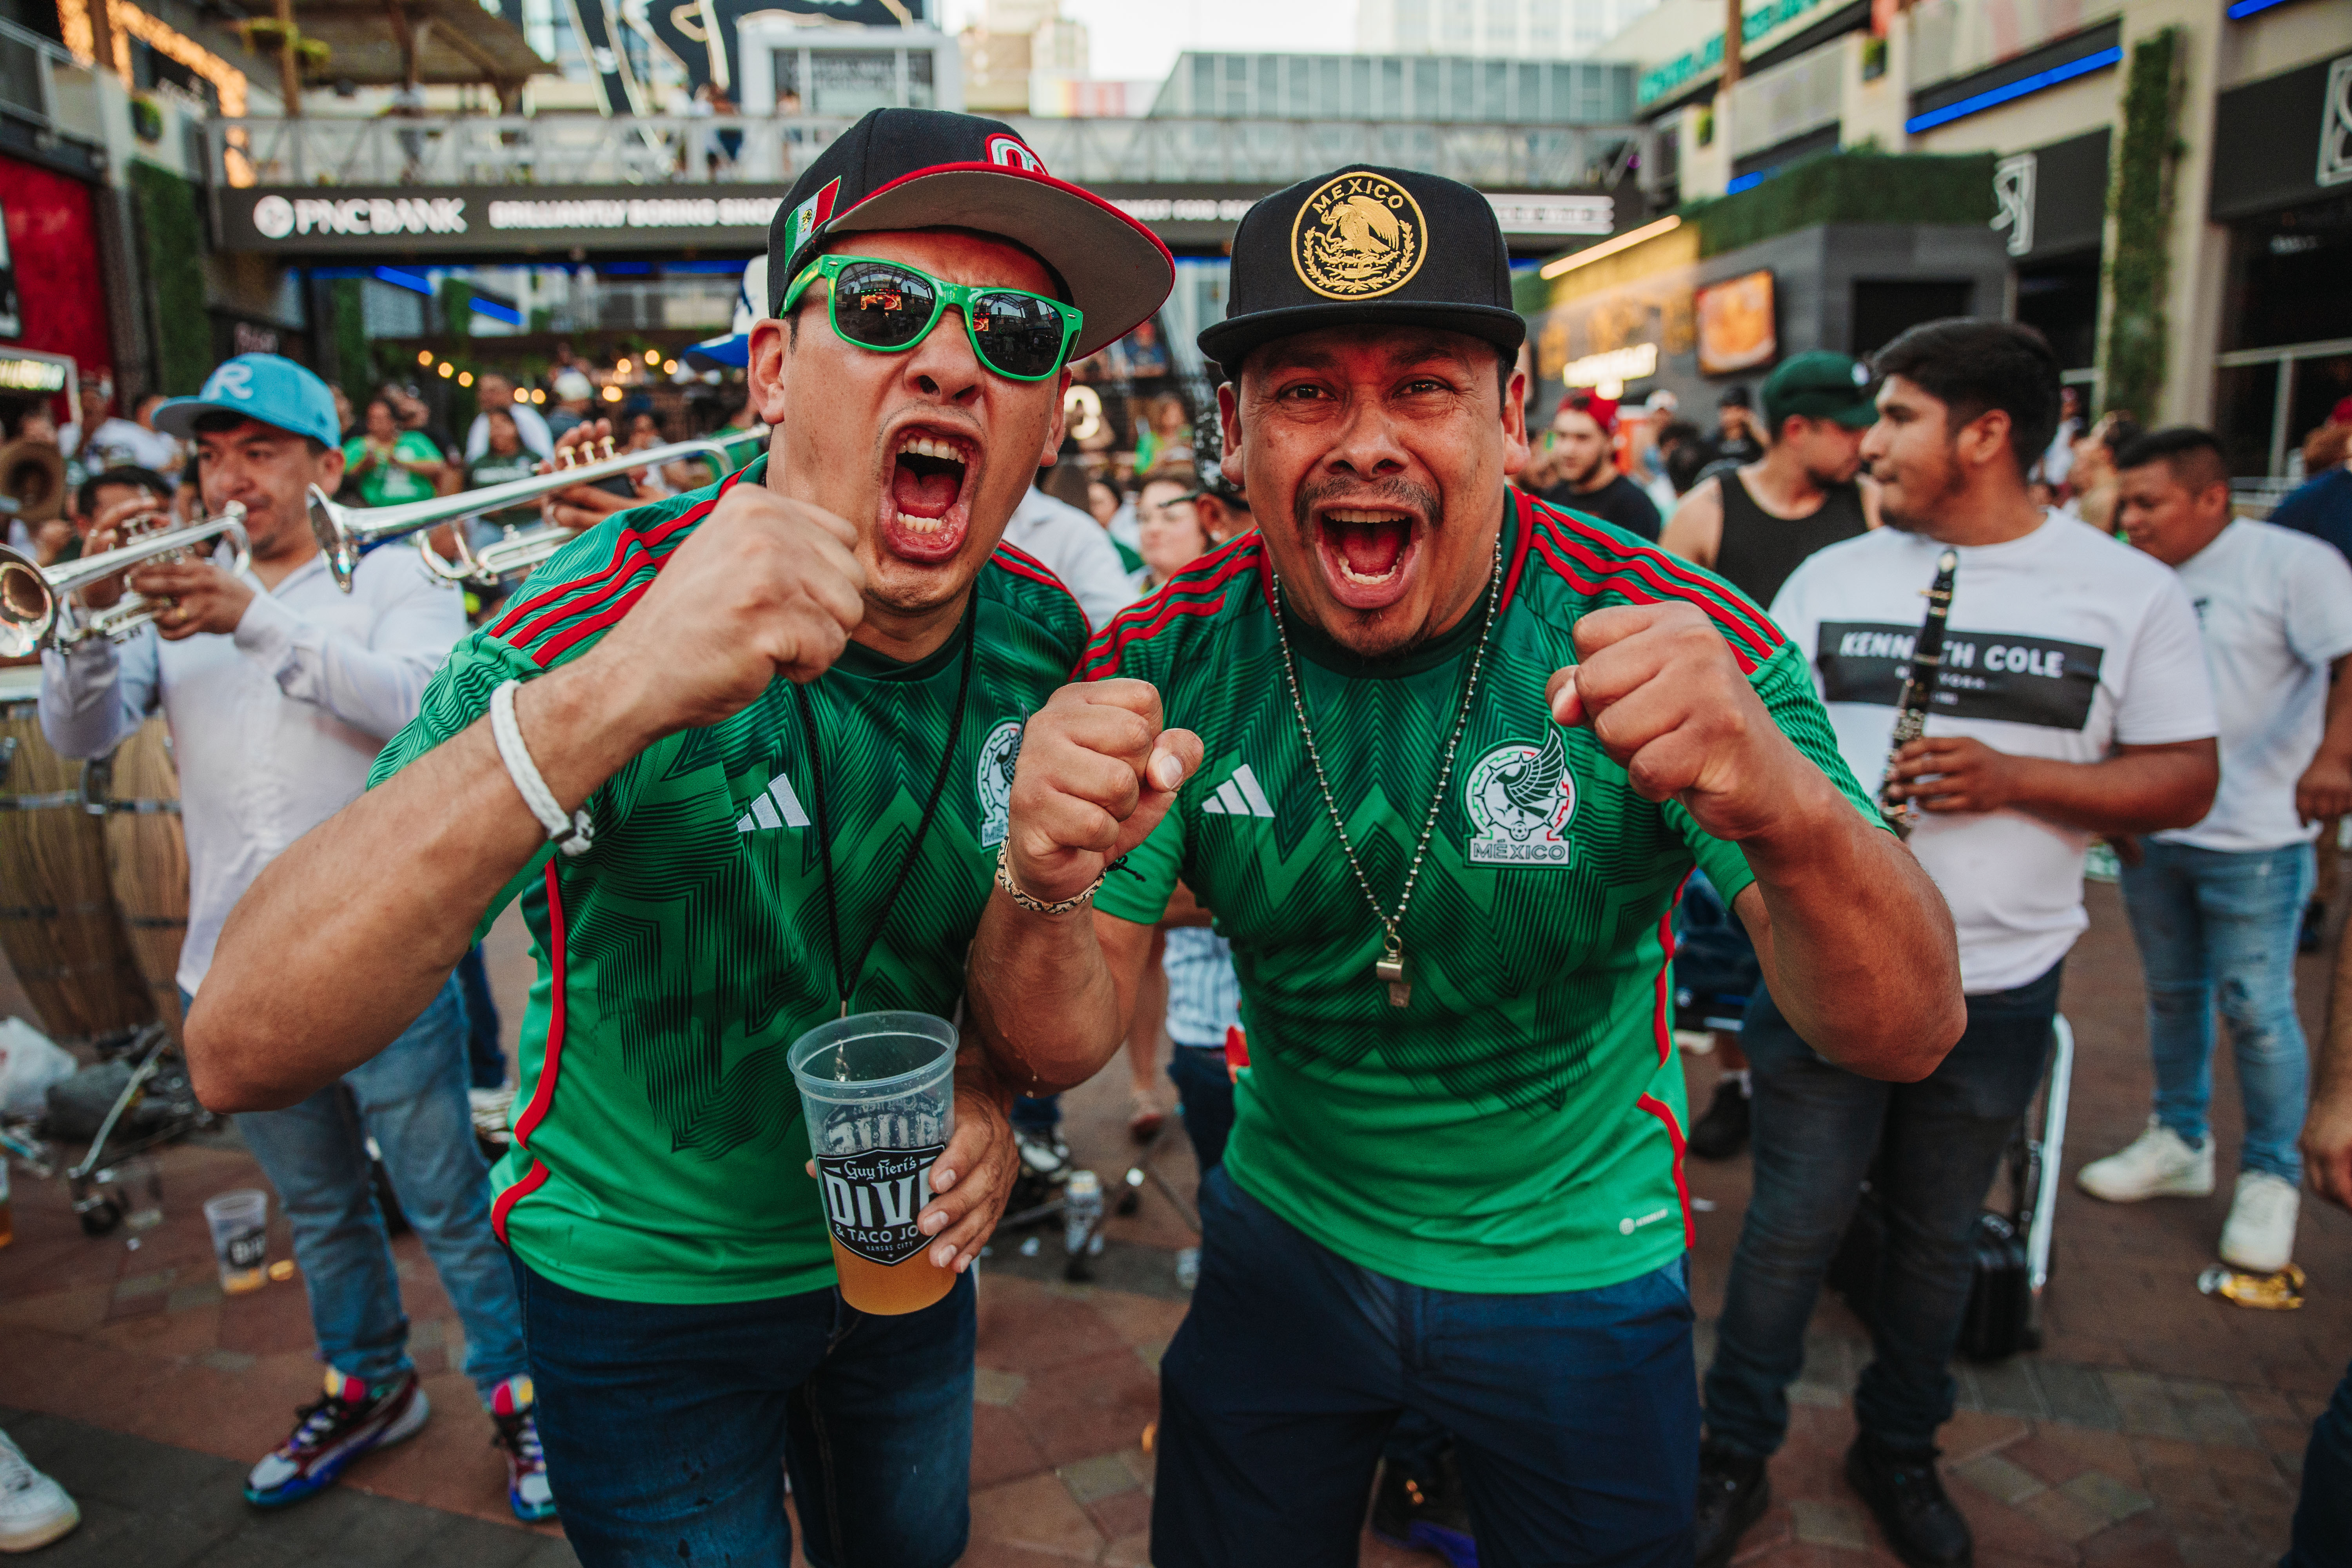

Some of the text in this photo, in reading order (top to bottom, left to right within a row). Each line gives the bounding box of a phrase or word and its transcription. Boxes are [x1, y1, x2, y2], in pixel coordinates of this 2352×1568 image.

[1312, 178, 1404, 214] MEXICO
[207, 361, 254, 400] R
[1838, 631, 2065, 679] KENNH COLE
[844, 1160, 876, 1181] Guy
[835, 1224, 845, 1238] &
[847, 1227, 893, 1243] TACO
[897, 1240, 913, 1250] CITY
